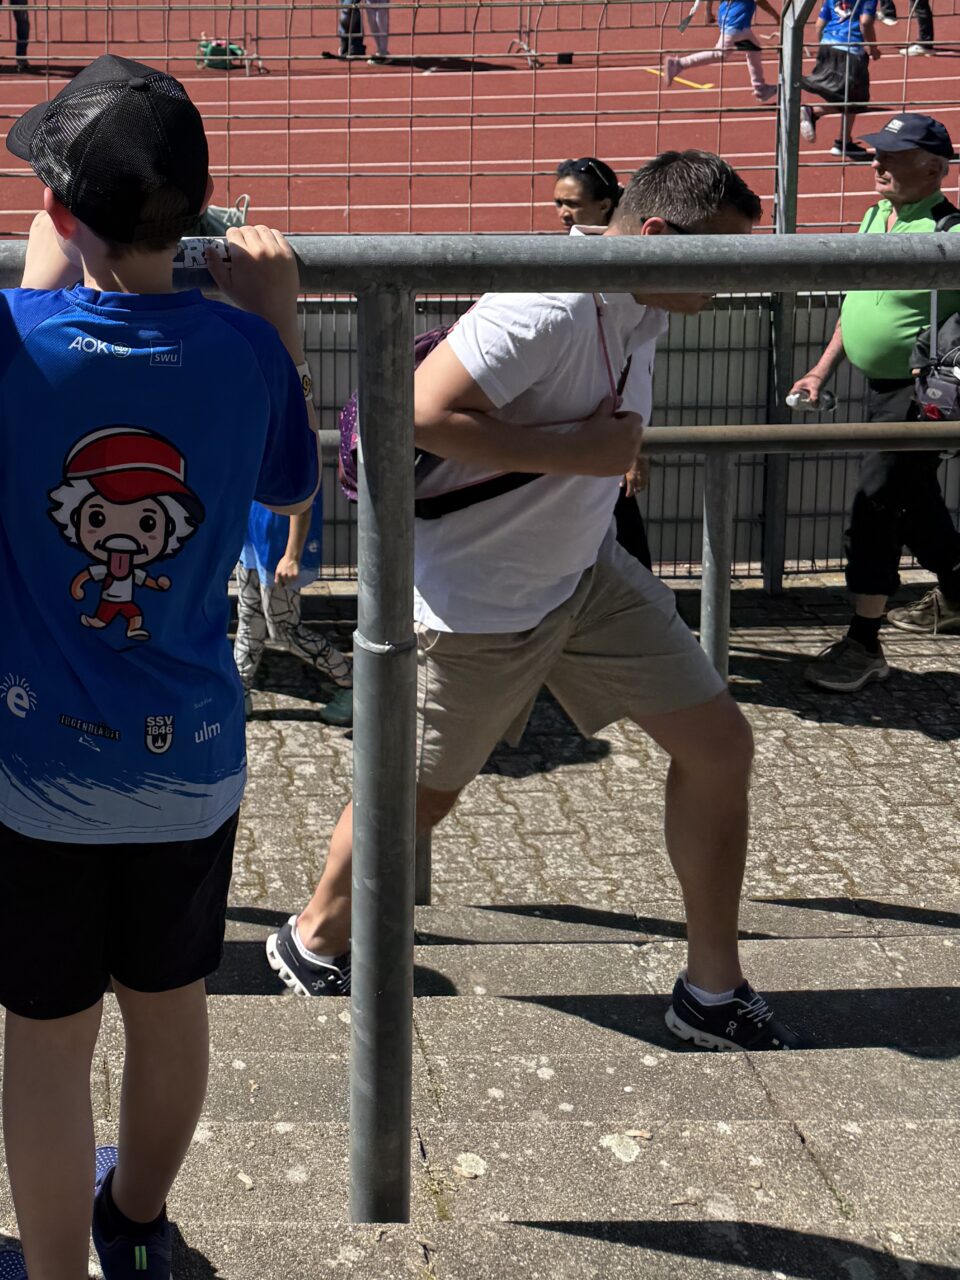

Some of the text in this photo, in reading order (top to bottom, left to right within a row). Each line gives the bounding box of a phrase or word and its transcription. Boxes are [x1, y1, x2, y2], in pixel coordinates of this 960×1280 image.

[68, 336, 109, 354] AOK
[154, 353, 178, 362] SWU
[146, 715, 173, 726] SSV
[146, 725, 173, 735] 1846
[194, 721, 221, 744] ulm
